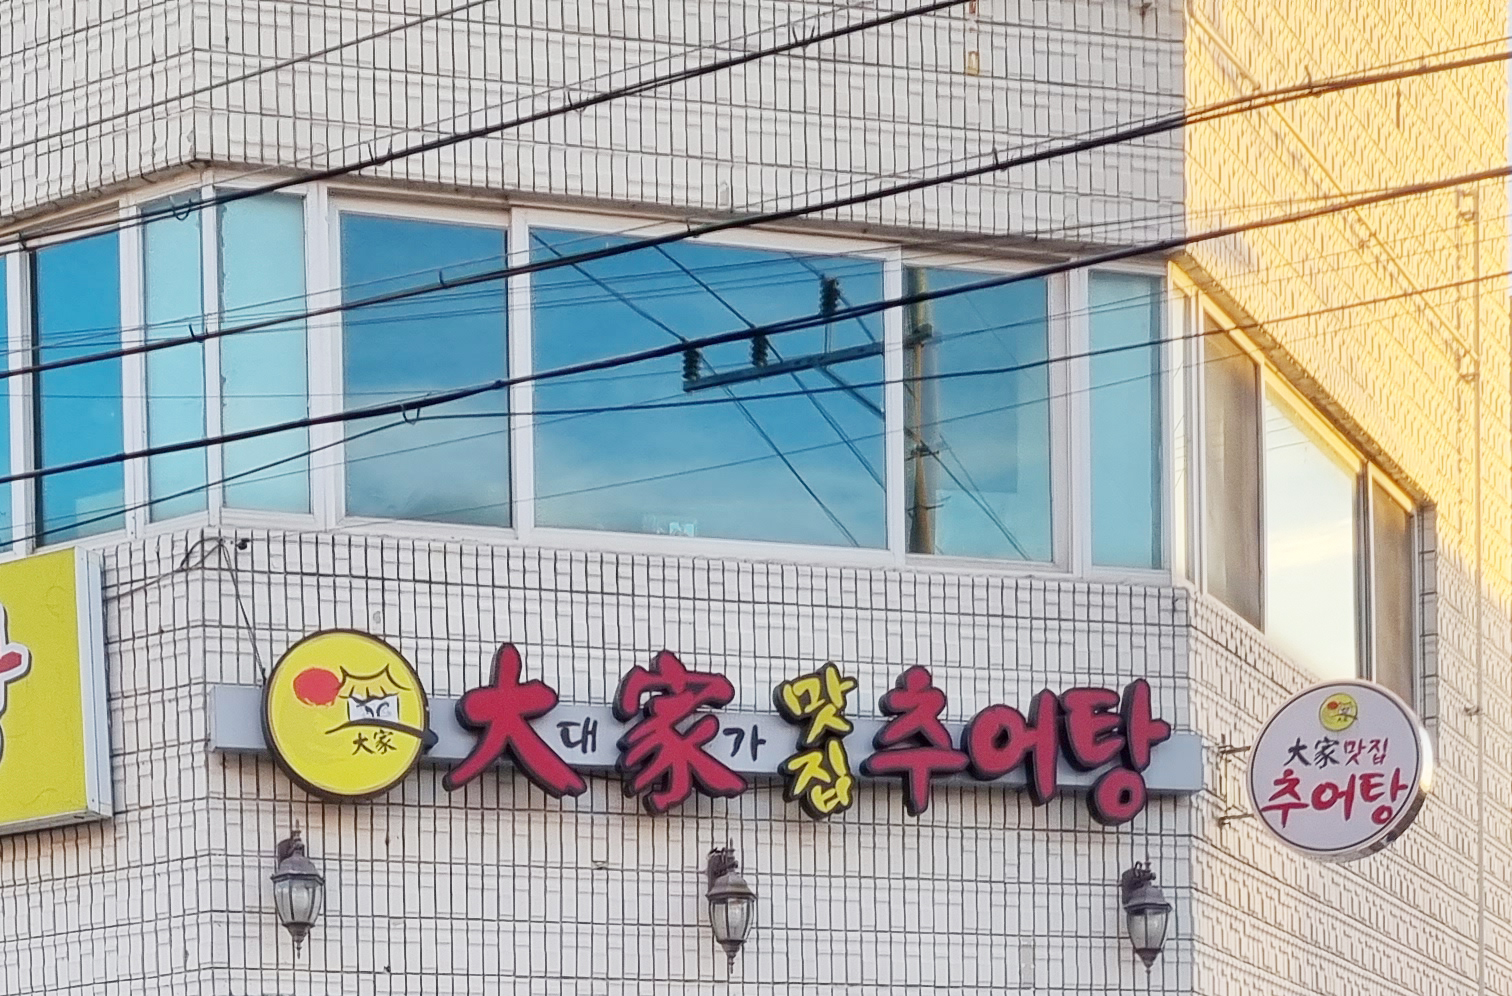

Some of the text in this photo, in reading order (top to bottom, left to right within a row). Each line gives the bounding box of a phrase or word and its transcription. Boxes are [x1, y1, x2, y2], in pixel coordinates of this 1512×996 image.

[774, 662, 857, 818] 맛집
[863, 665, 1170, 825] 추어탕
[1260, 767, 1408, 828] 추어탕
